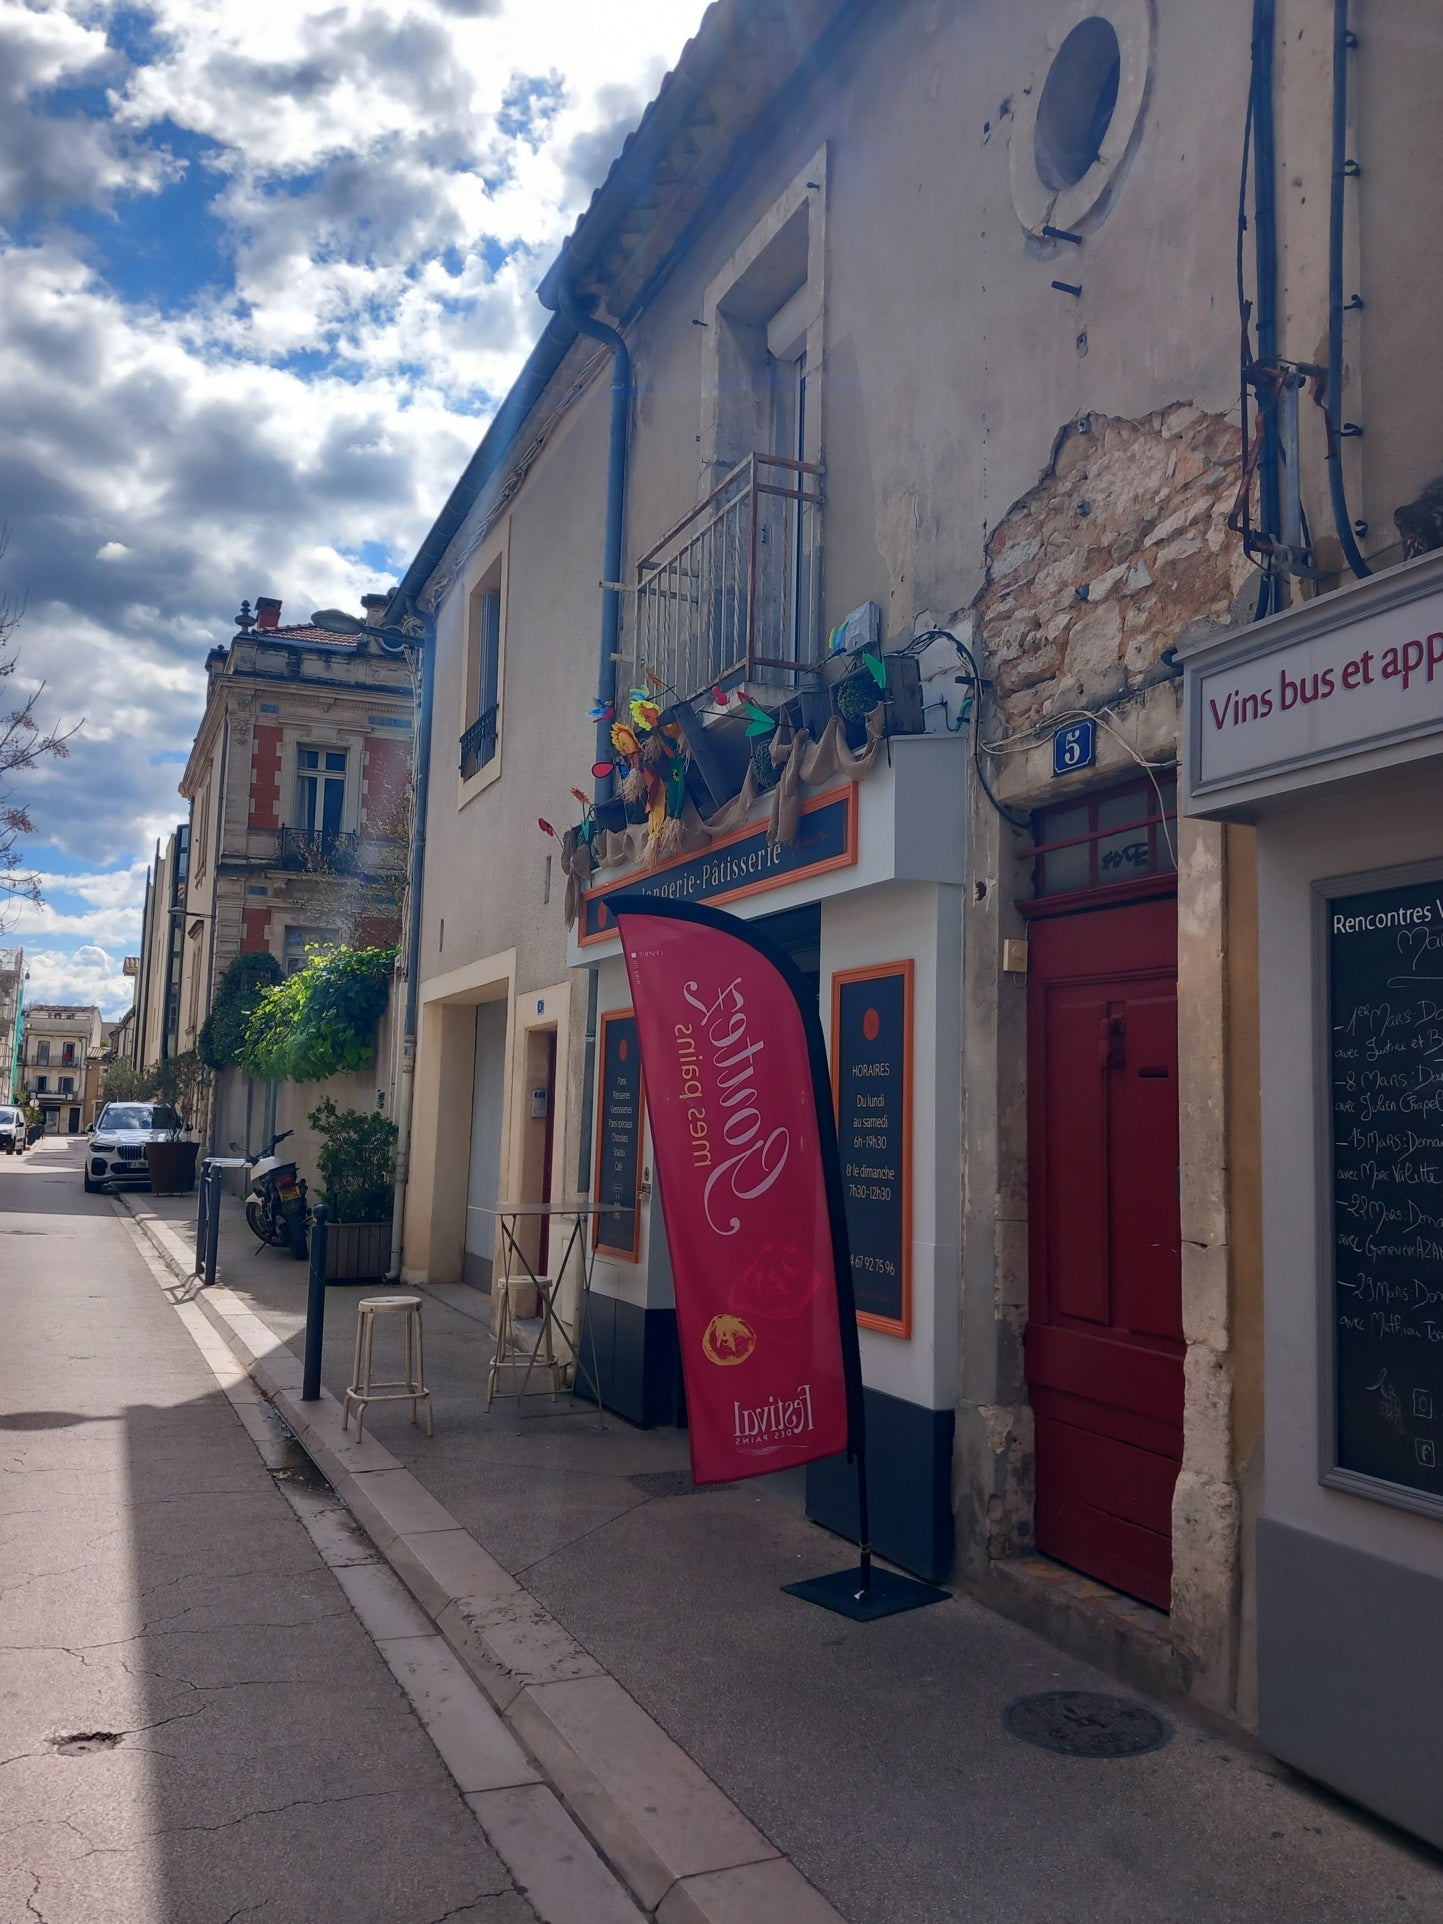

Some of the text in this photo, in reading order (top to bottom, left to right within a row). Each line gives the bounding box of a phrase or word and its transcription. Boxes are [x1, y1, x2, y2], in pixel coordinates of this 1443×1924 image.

[1209, 689, 1273, 730] Vins
[1280, 669, 1335, 710] bus
[1342, 650, 1375, 690] et
[1064, 729, 1081, 765] 5
[641, 843, 782, 899] ngerie-Pâtisserie
[1333, 904, 1432, 934] Rencontres
[1410, 1036, 1425, 1050] et
[852, 1063, 890, 1077] HORAIRES
[856, 1093, 885, 1107] Du lundi
[852, 1115, 888, 1128] au samedi
[853, 1135, 887, 1149] 6h-19h30
[852, 1165, 859, 1177] le
[859, 1164, 895, 1180] dimanche
[848, 1184, 891, 1201] 7h30-12h30
[854, 1255, 864, 1269] 67
[864, 1256, 874, 1271] 92
[875, 1258, 884, 1273] 75
[884, 1260, 895, 1276] 96
